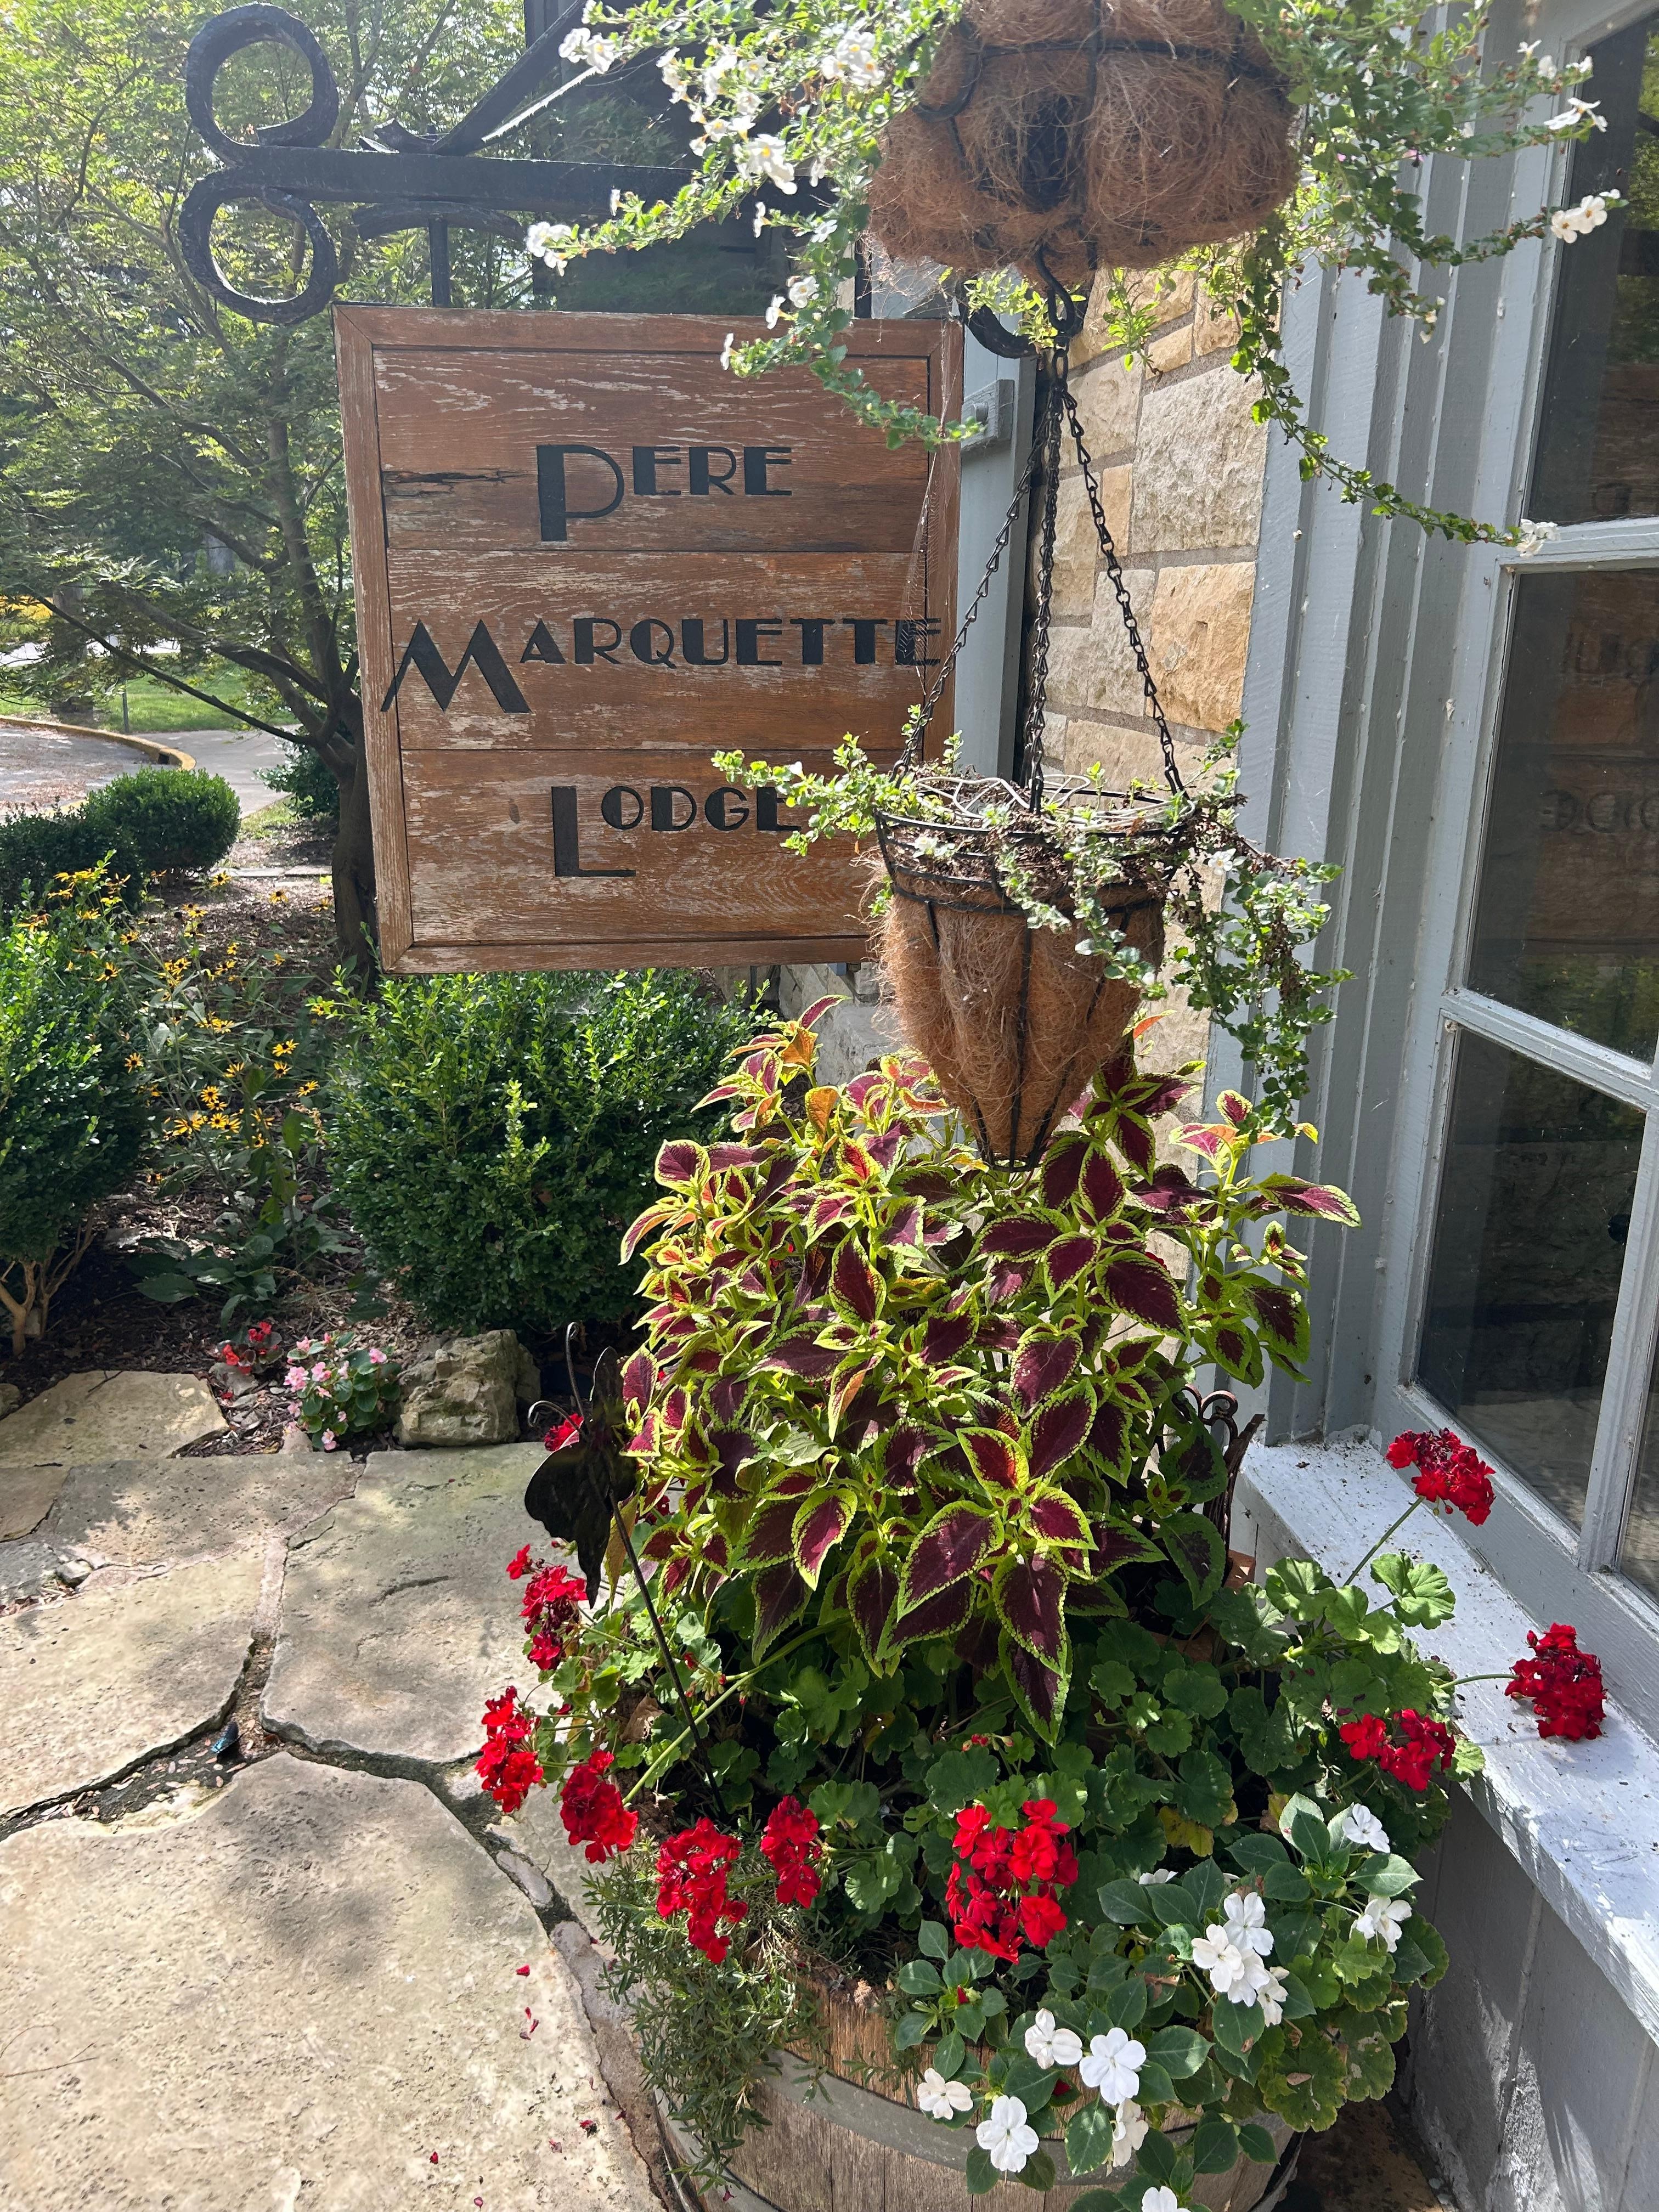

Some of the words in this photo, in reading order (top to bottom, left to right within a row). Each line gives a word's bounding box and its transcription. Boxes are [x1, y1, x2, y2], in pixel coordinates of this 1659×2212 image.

[536, 444, 792, 542] PERE
[381, 618, 941, 713] MARQUETTE
[551, 785, 802, 878] LODGE
